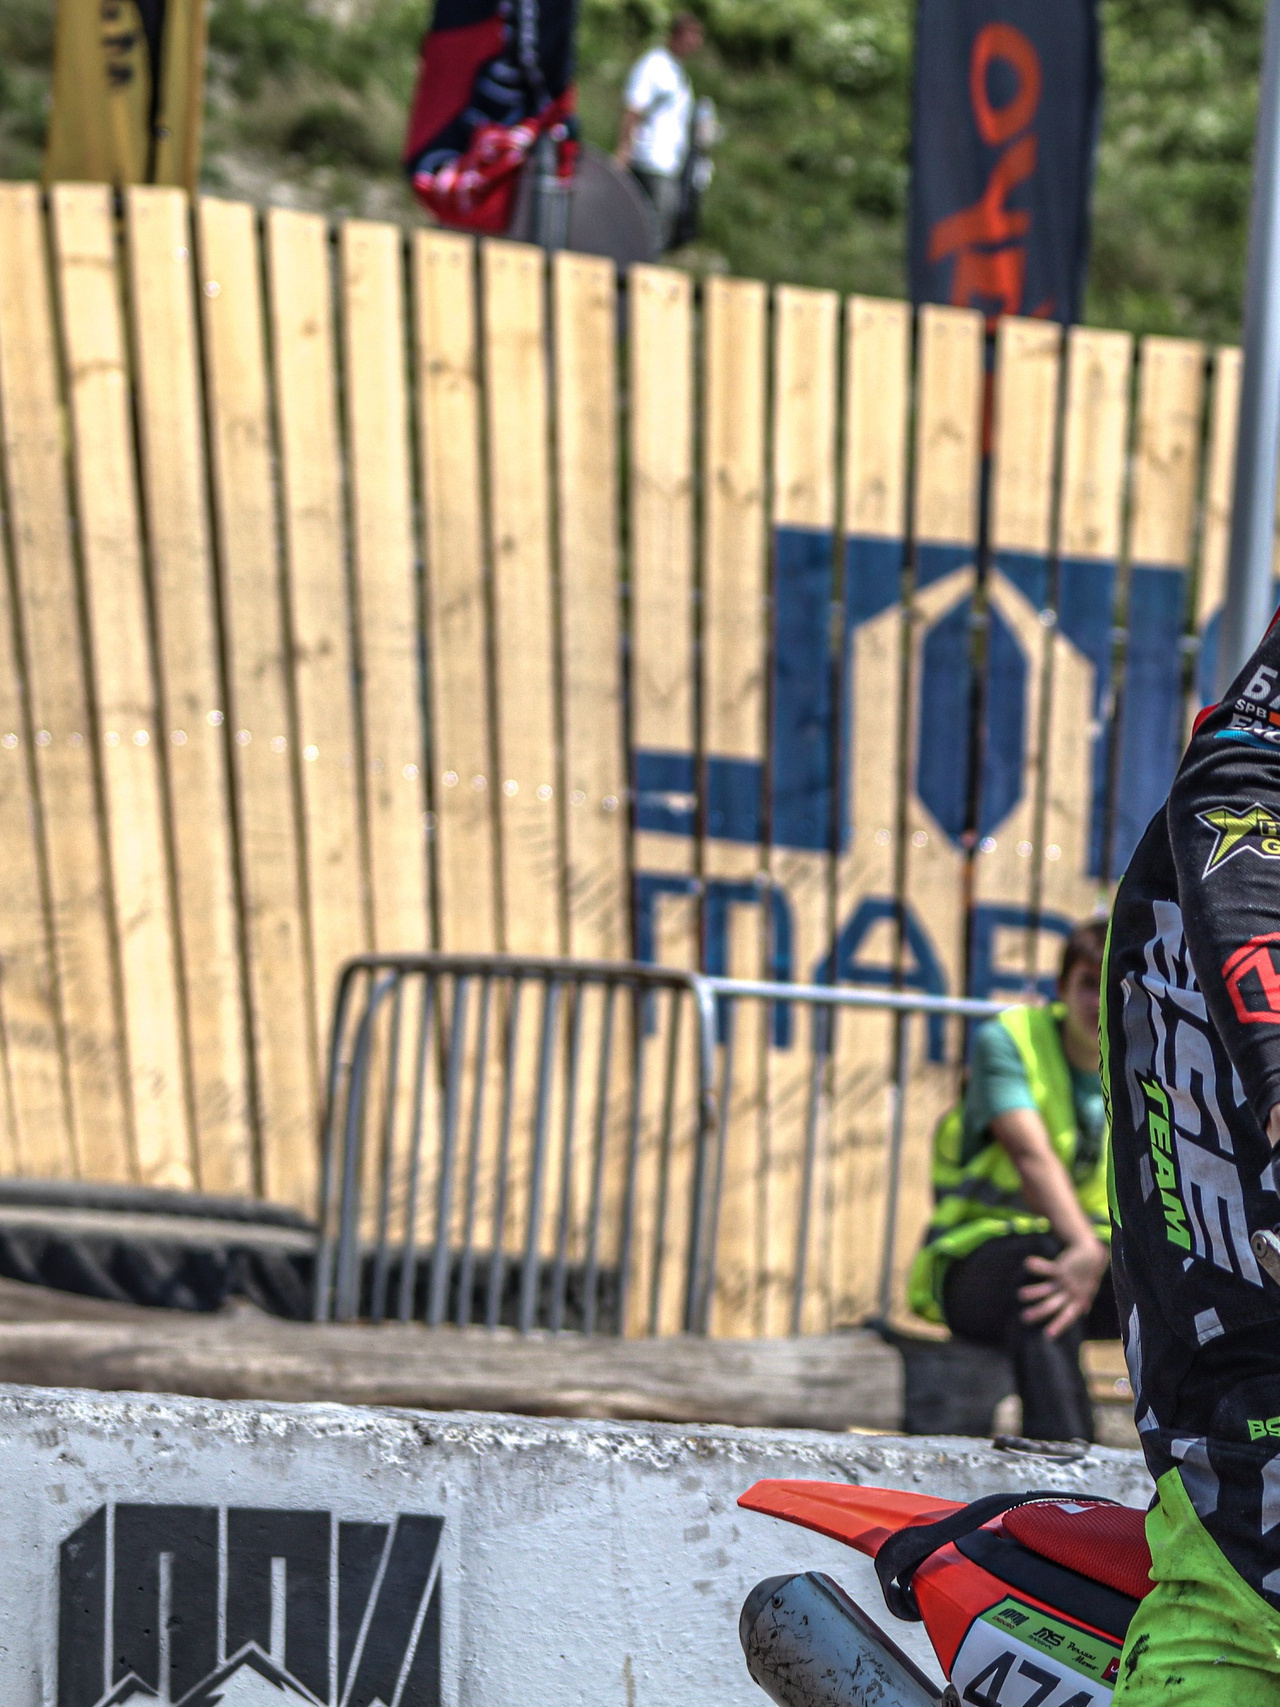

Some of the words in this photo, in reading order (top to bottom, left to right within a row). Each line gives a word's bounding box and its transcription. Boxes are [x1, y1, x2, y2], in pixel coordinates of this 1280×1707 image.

[1234, 699, 1268, 719] SPB
[1142, 1079, 1192, 1252] TEAM
[962, 1650, 1094, 1707] 47
